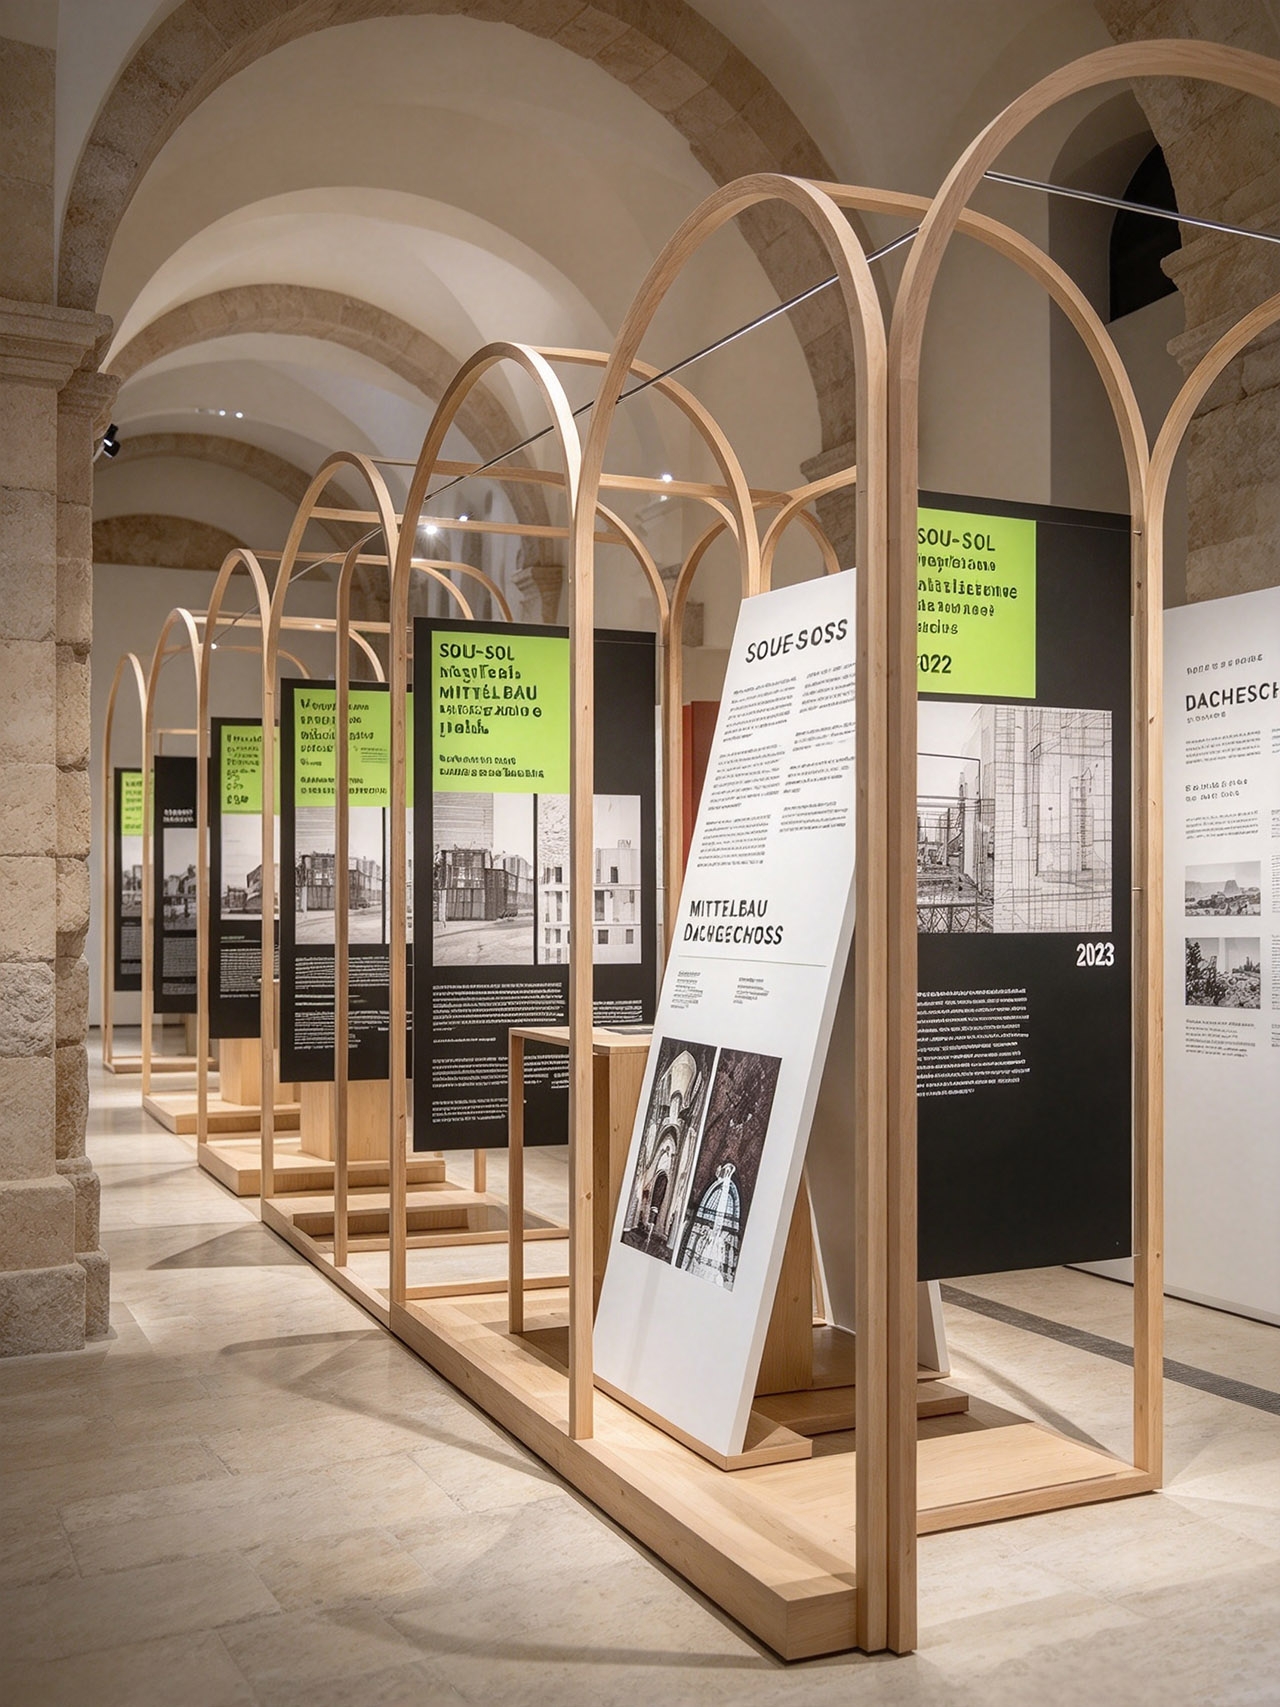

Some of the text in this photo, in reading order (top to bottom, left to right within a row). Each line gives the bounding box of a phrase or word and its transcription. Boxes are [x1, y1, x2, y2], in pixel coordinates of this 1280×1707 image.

[918, 527, 996, 552] SOU-SOL
[439, 643, 515, 661] SOU-SOL
[918, 653, 952, 674] 022
[689, 899, 768, 918] MITTELBAU
[1076, 942, 1115, 967] 2023
